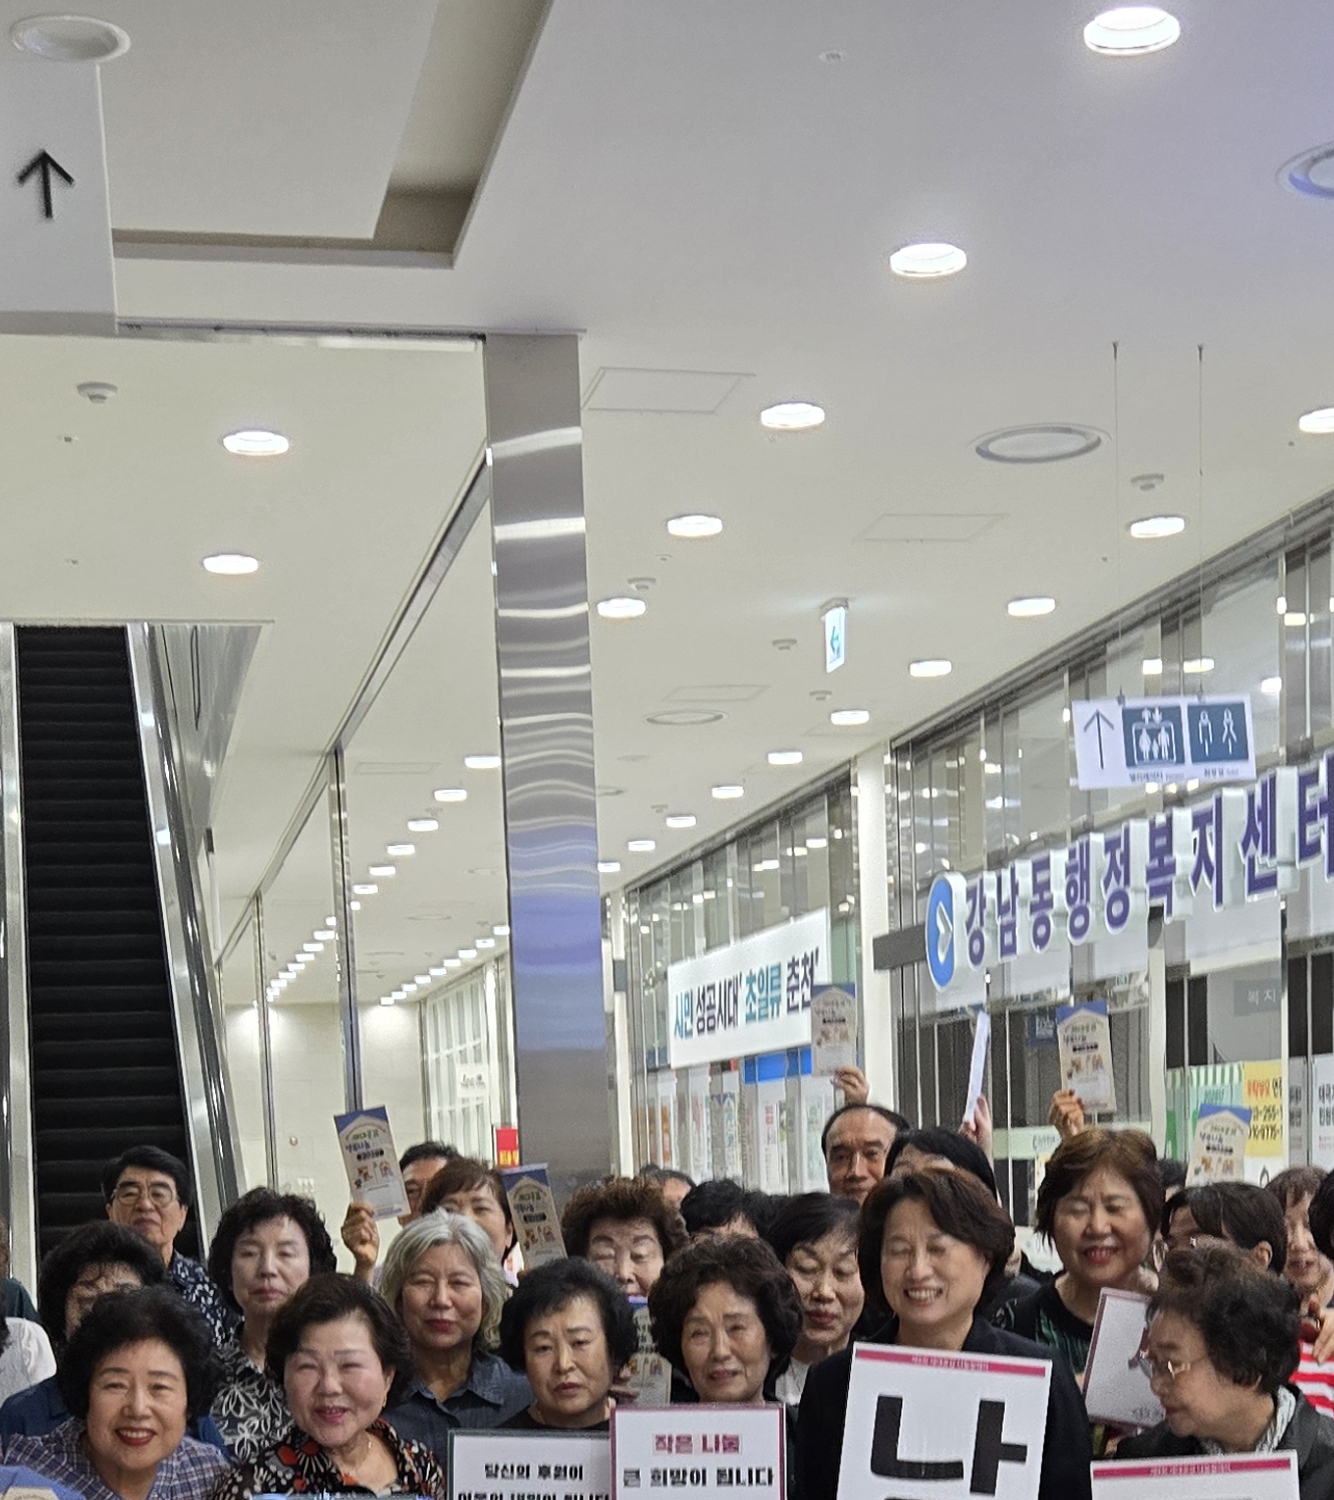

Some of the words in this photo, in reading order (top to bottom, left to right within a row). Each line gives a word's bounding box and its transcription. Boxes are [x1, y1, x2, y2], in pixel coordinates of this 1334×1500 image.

[673, 987, 694, 1040] 시민
[484, 1463, 531, 1481] 당신의
[537, 1464, 584, 1482] 후원이
[650, 1467, 707, 1488] 희망이
[716, 1467, 774, 1488] 됩니다
